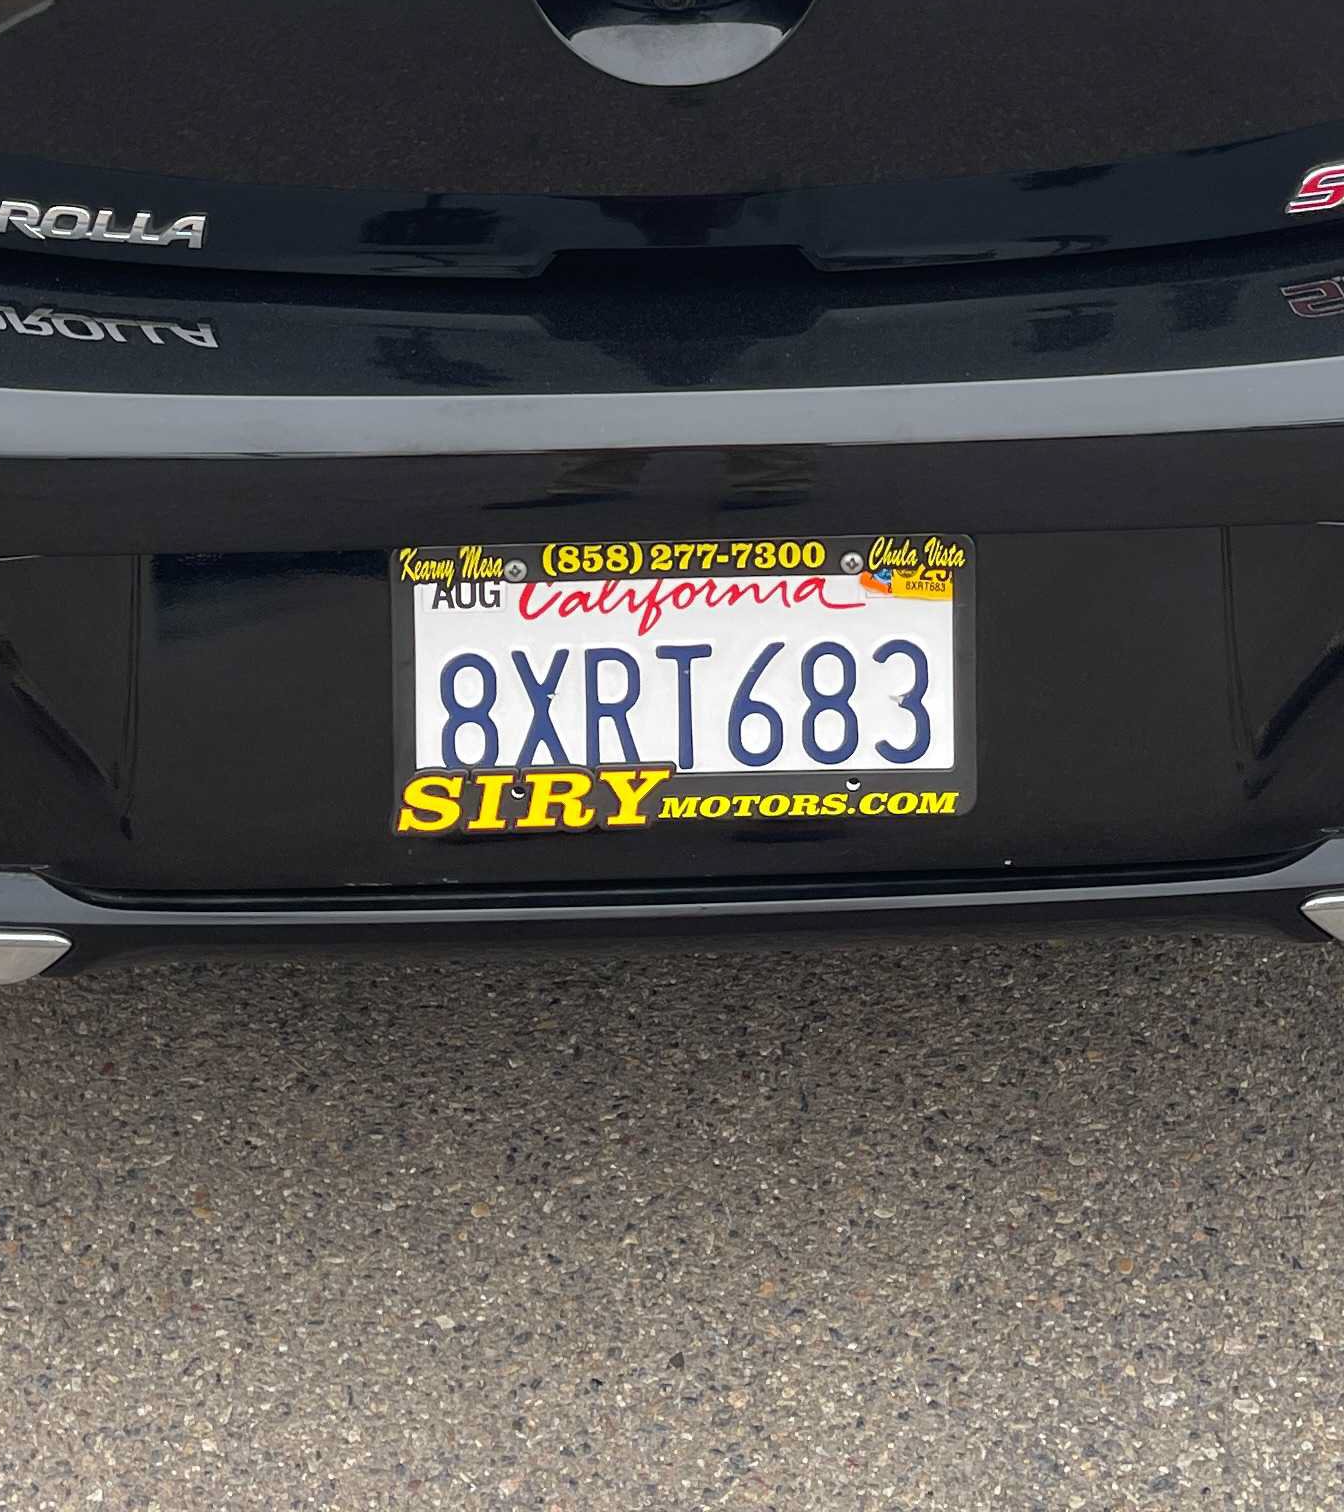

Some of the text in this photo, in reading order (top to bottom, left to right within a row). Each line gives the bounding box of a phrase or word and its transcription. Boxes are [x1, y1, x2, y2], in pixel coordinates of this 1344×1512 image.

[399, 545, 504, 588] Kearny Mesa
[542, 541, 826, 578] (858) 277-7300
[868, 536, 966, 571] Chula Vista
[432, 580, 501, 609] AUG
[518, 575, 866, 637] California
[439, 639, 931, 771] 8XRT683
[398, 769, 959, 831] SIRY MOTORS.COM
